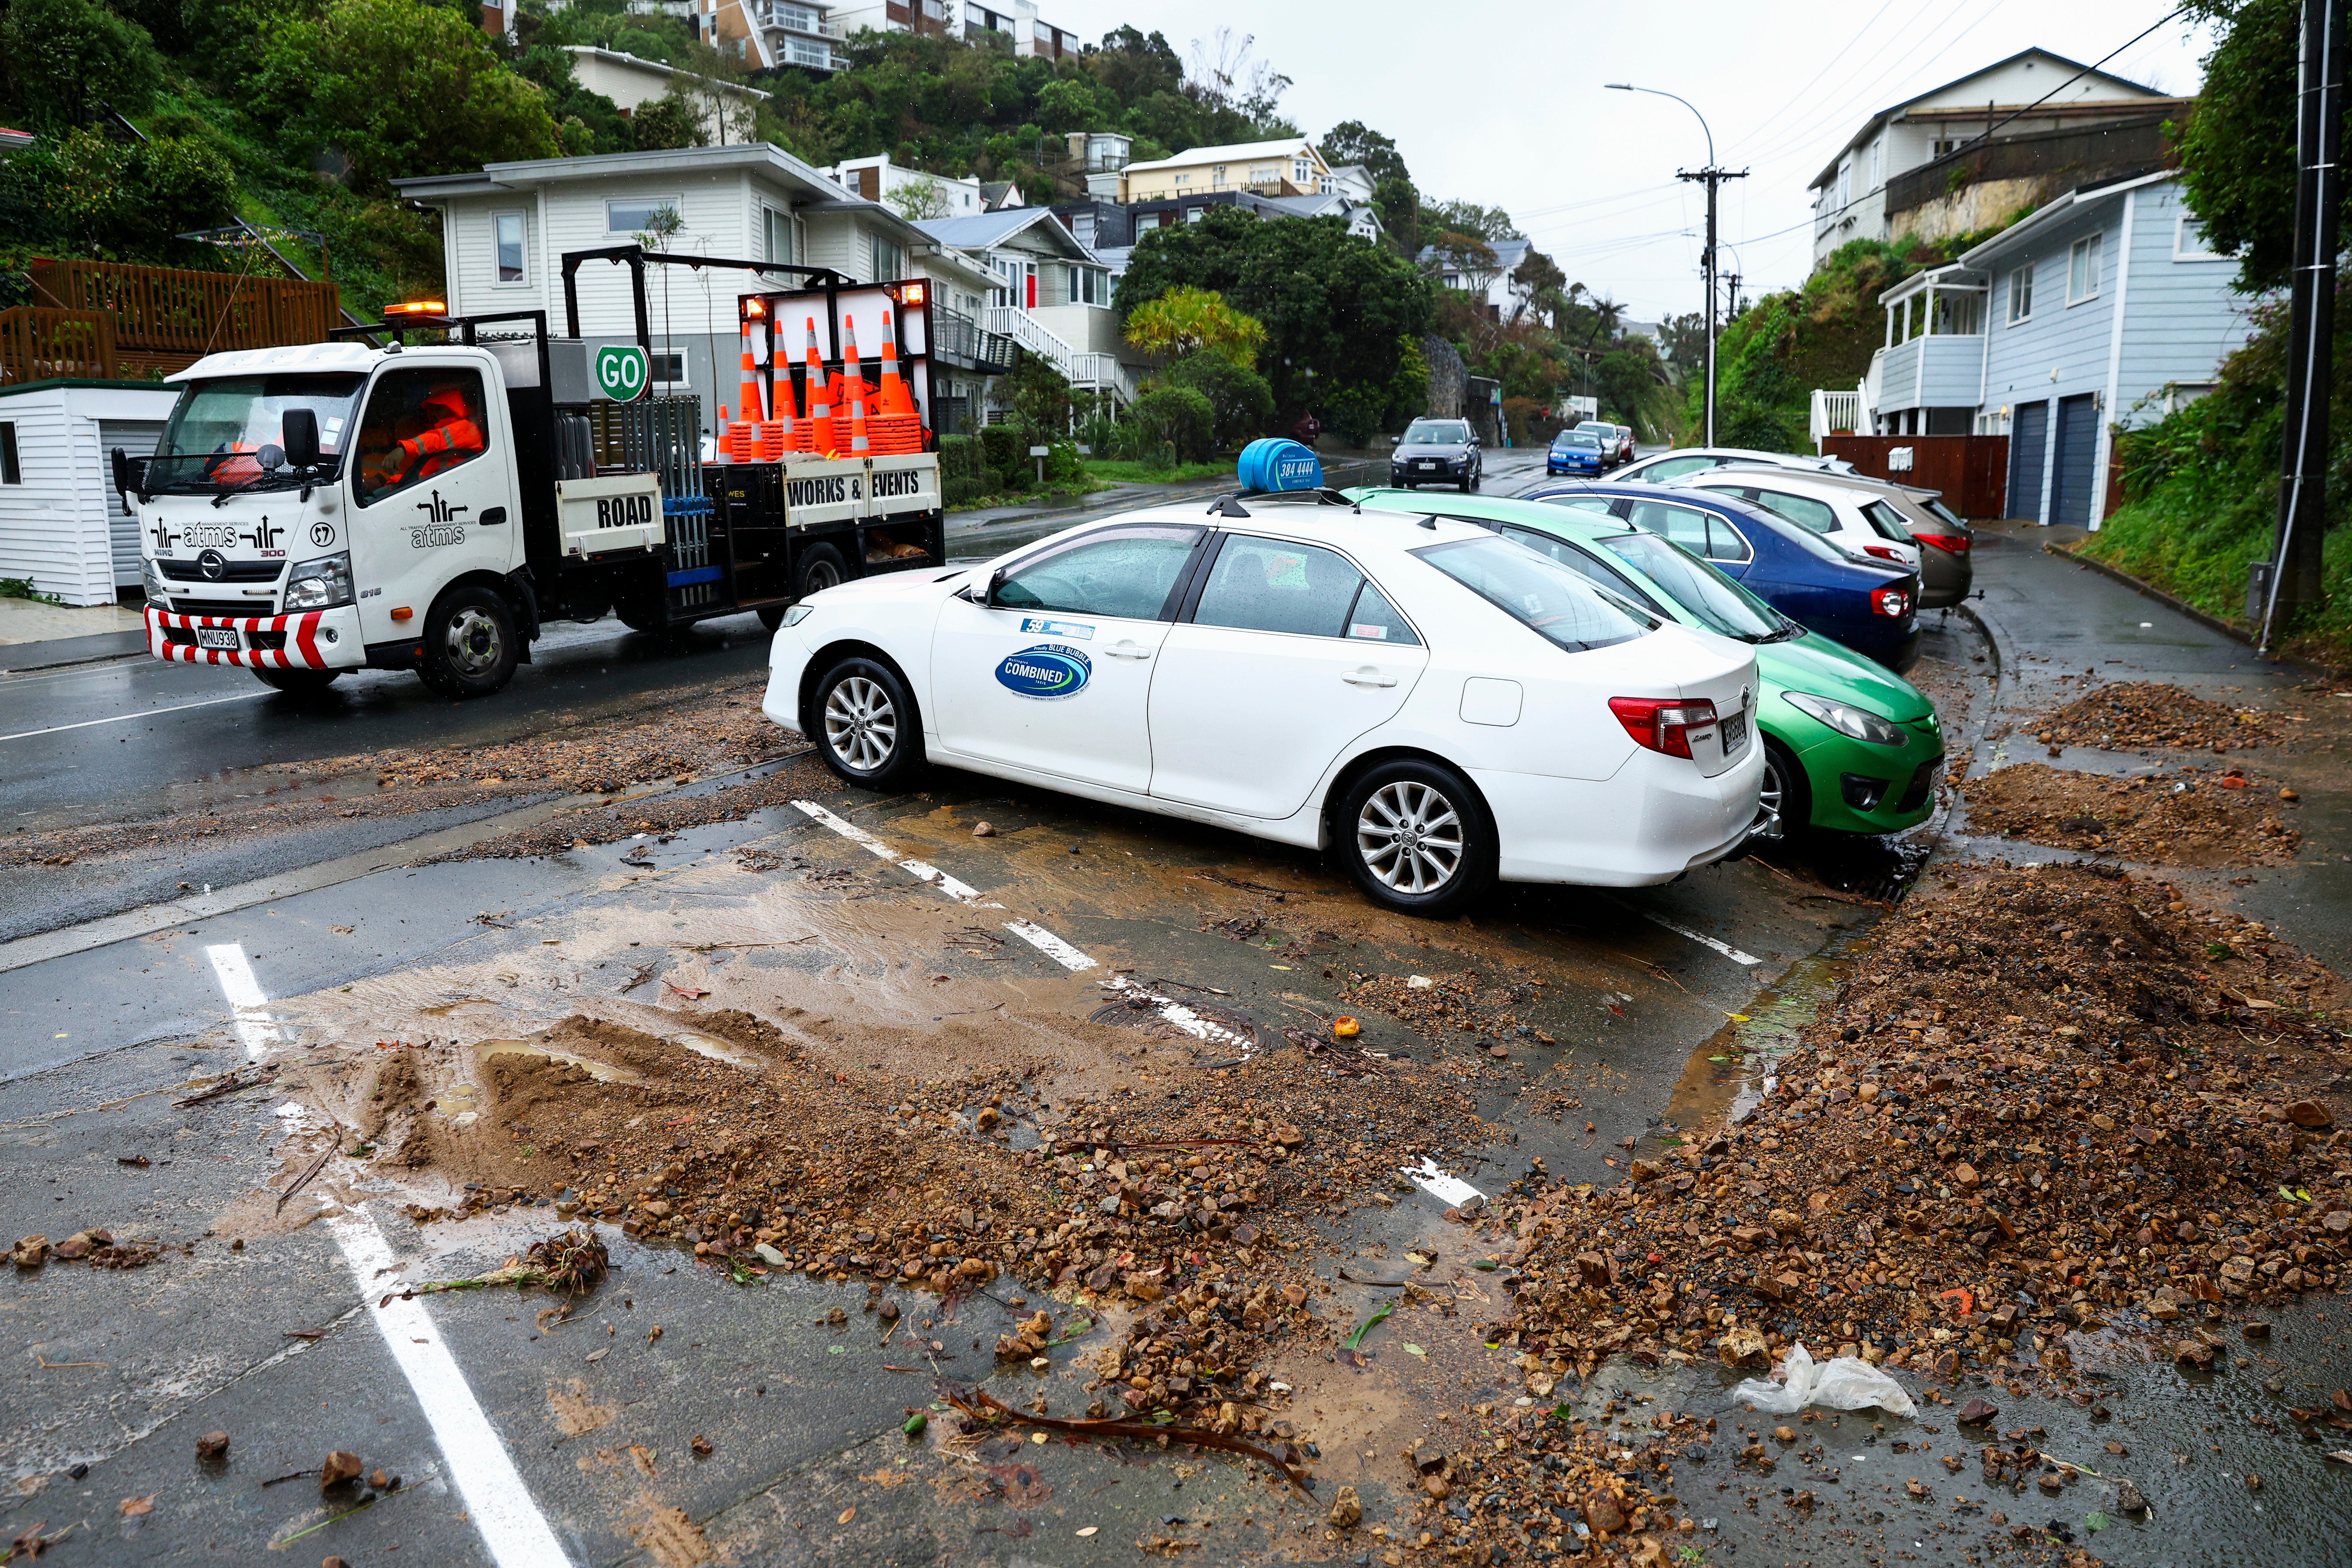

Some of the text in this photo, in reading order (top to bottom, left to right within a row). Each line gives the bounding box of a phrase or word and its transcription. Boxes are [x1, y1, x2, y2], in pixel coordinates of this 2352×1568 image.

[602, 354, 639, 388] GO
[1281, 461, 1314, 477] 384 4444
[787, 470, 919, 507] WORKS & EVENTS
[597, 496, 652, 528] ROAD
[184, 521, 237, 547] atms
[412, 524, 465, 548] atms
[1026, 619, 1044, 633] 59
[201, 631, 236, 646] MNU938
[1048, 644, 1065, 652] BLUE
[1066, 647, 1091, 664] BUBBLE
[1005, 662, 1063, 683] COMBINED
